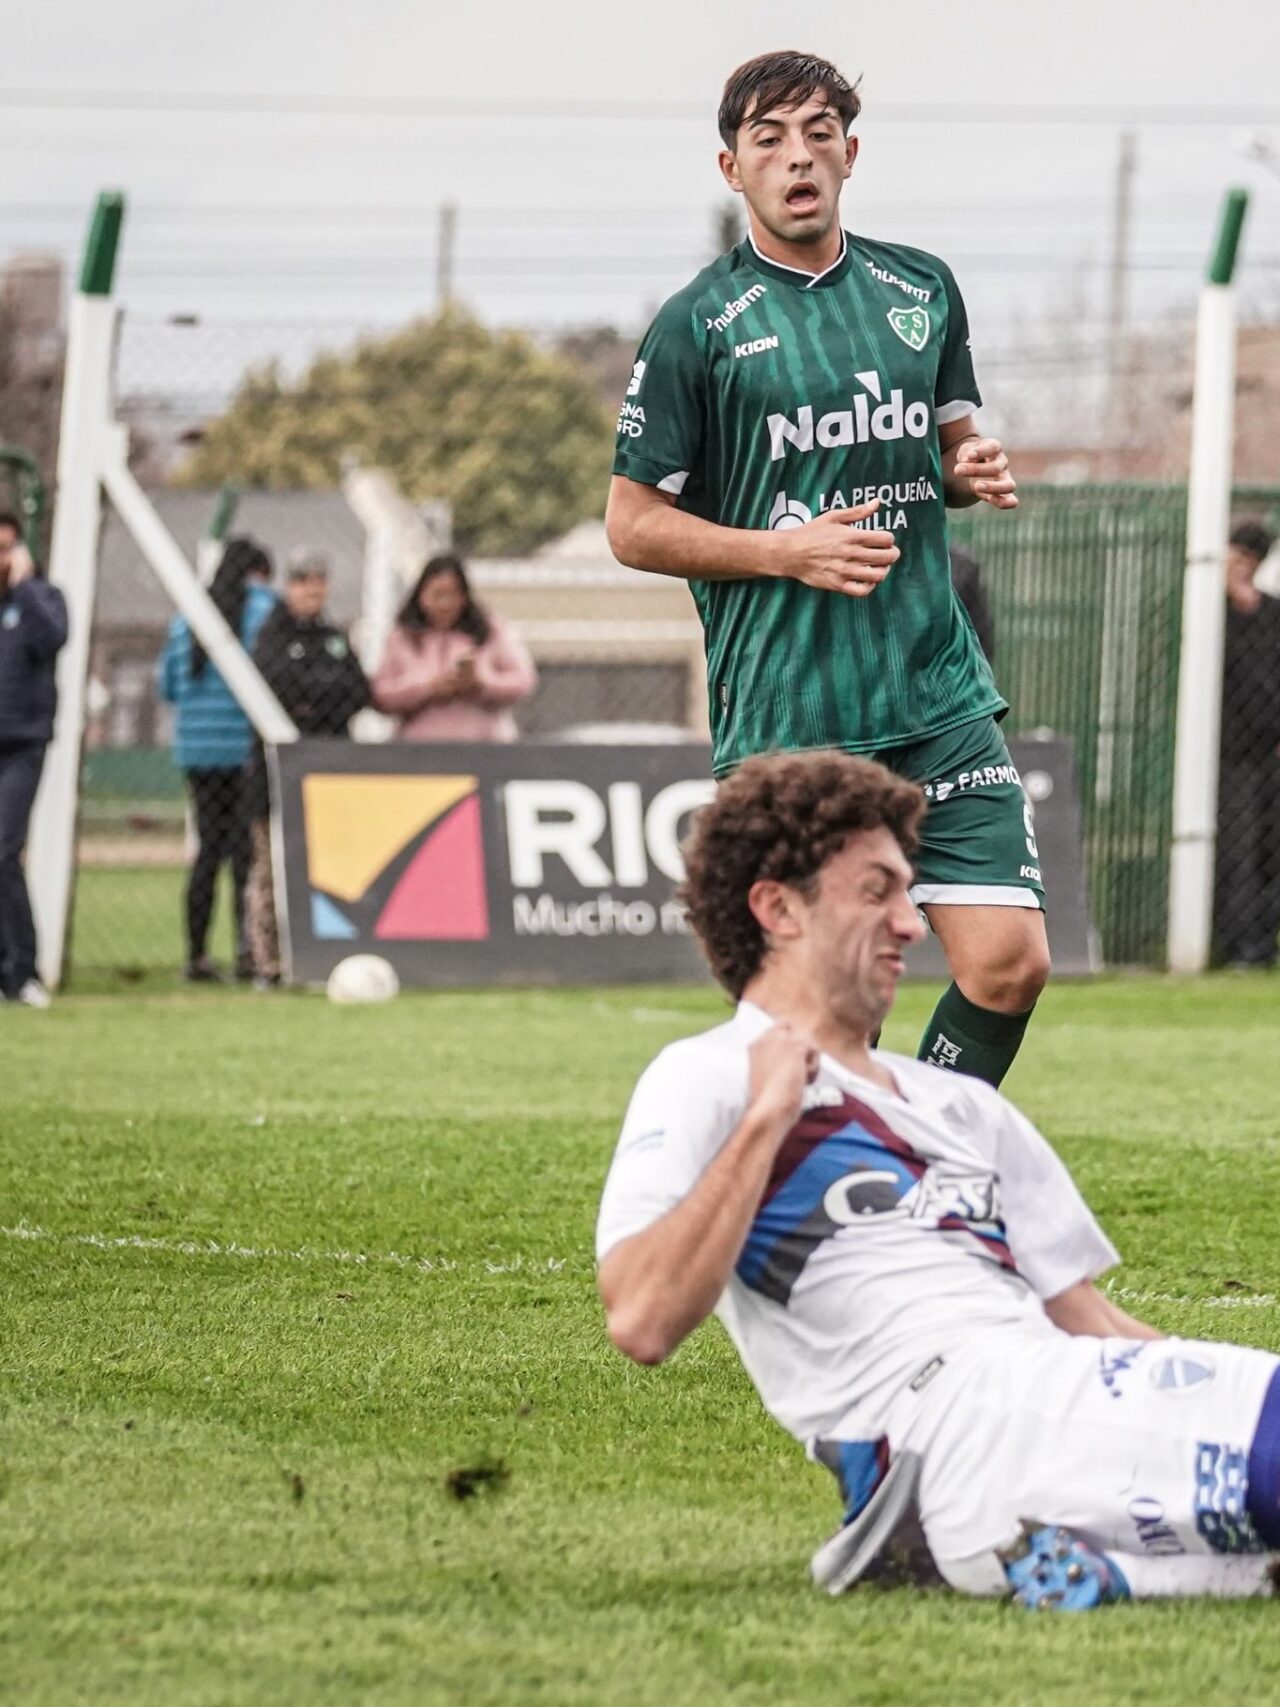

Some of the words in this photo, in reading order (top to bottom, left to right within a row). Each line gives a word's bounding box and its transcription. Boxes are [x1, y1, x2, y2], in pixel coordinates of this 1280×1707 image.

[712, 283, 767, 332] nufarm
[734, 335, 780, 358] KION
[767, 371, 929, 462] Naldo
[819, 490, 847, 512] LA
[853, 476, 938, 508] PEQUEÑA
[850, 509, 908, 531] ILIA
[512, 893, 657, 937] Mucho
